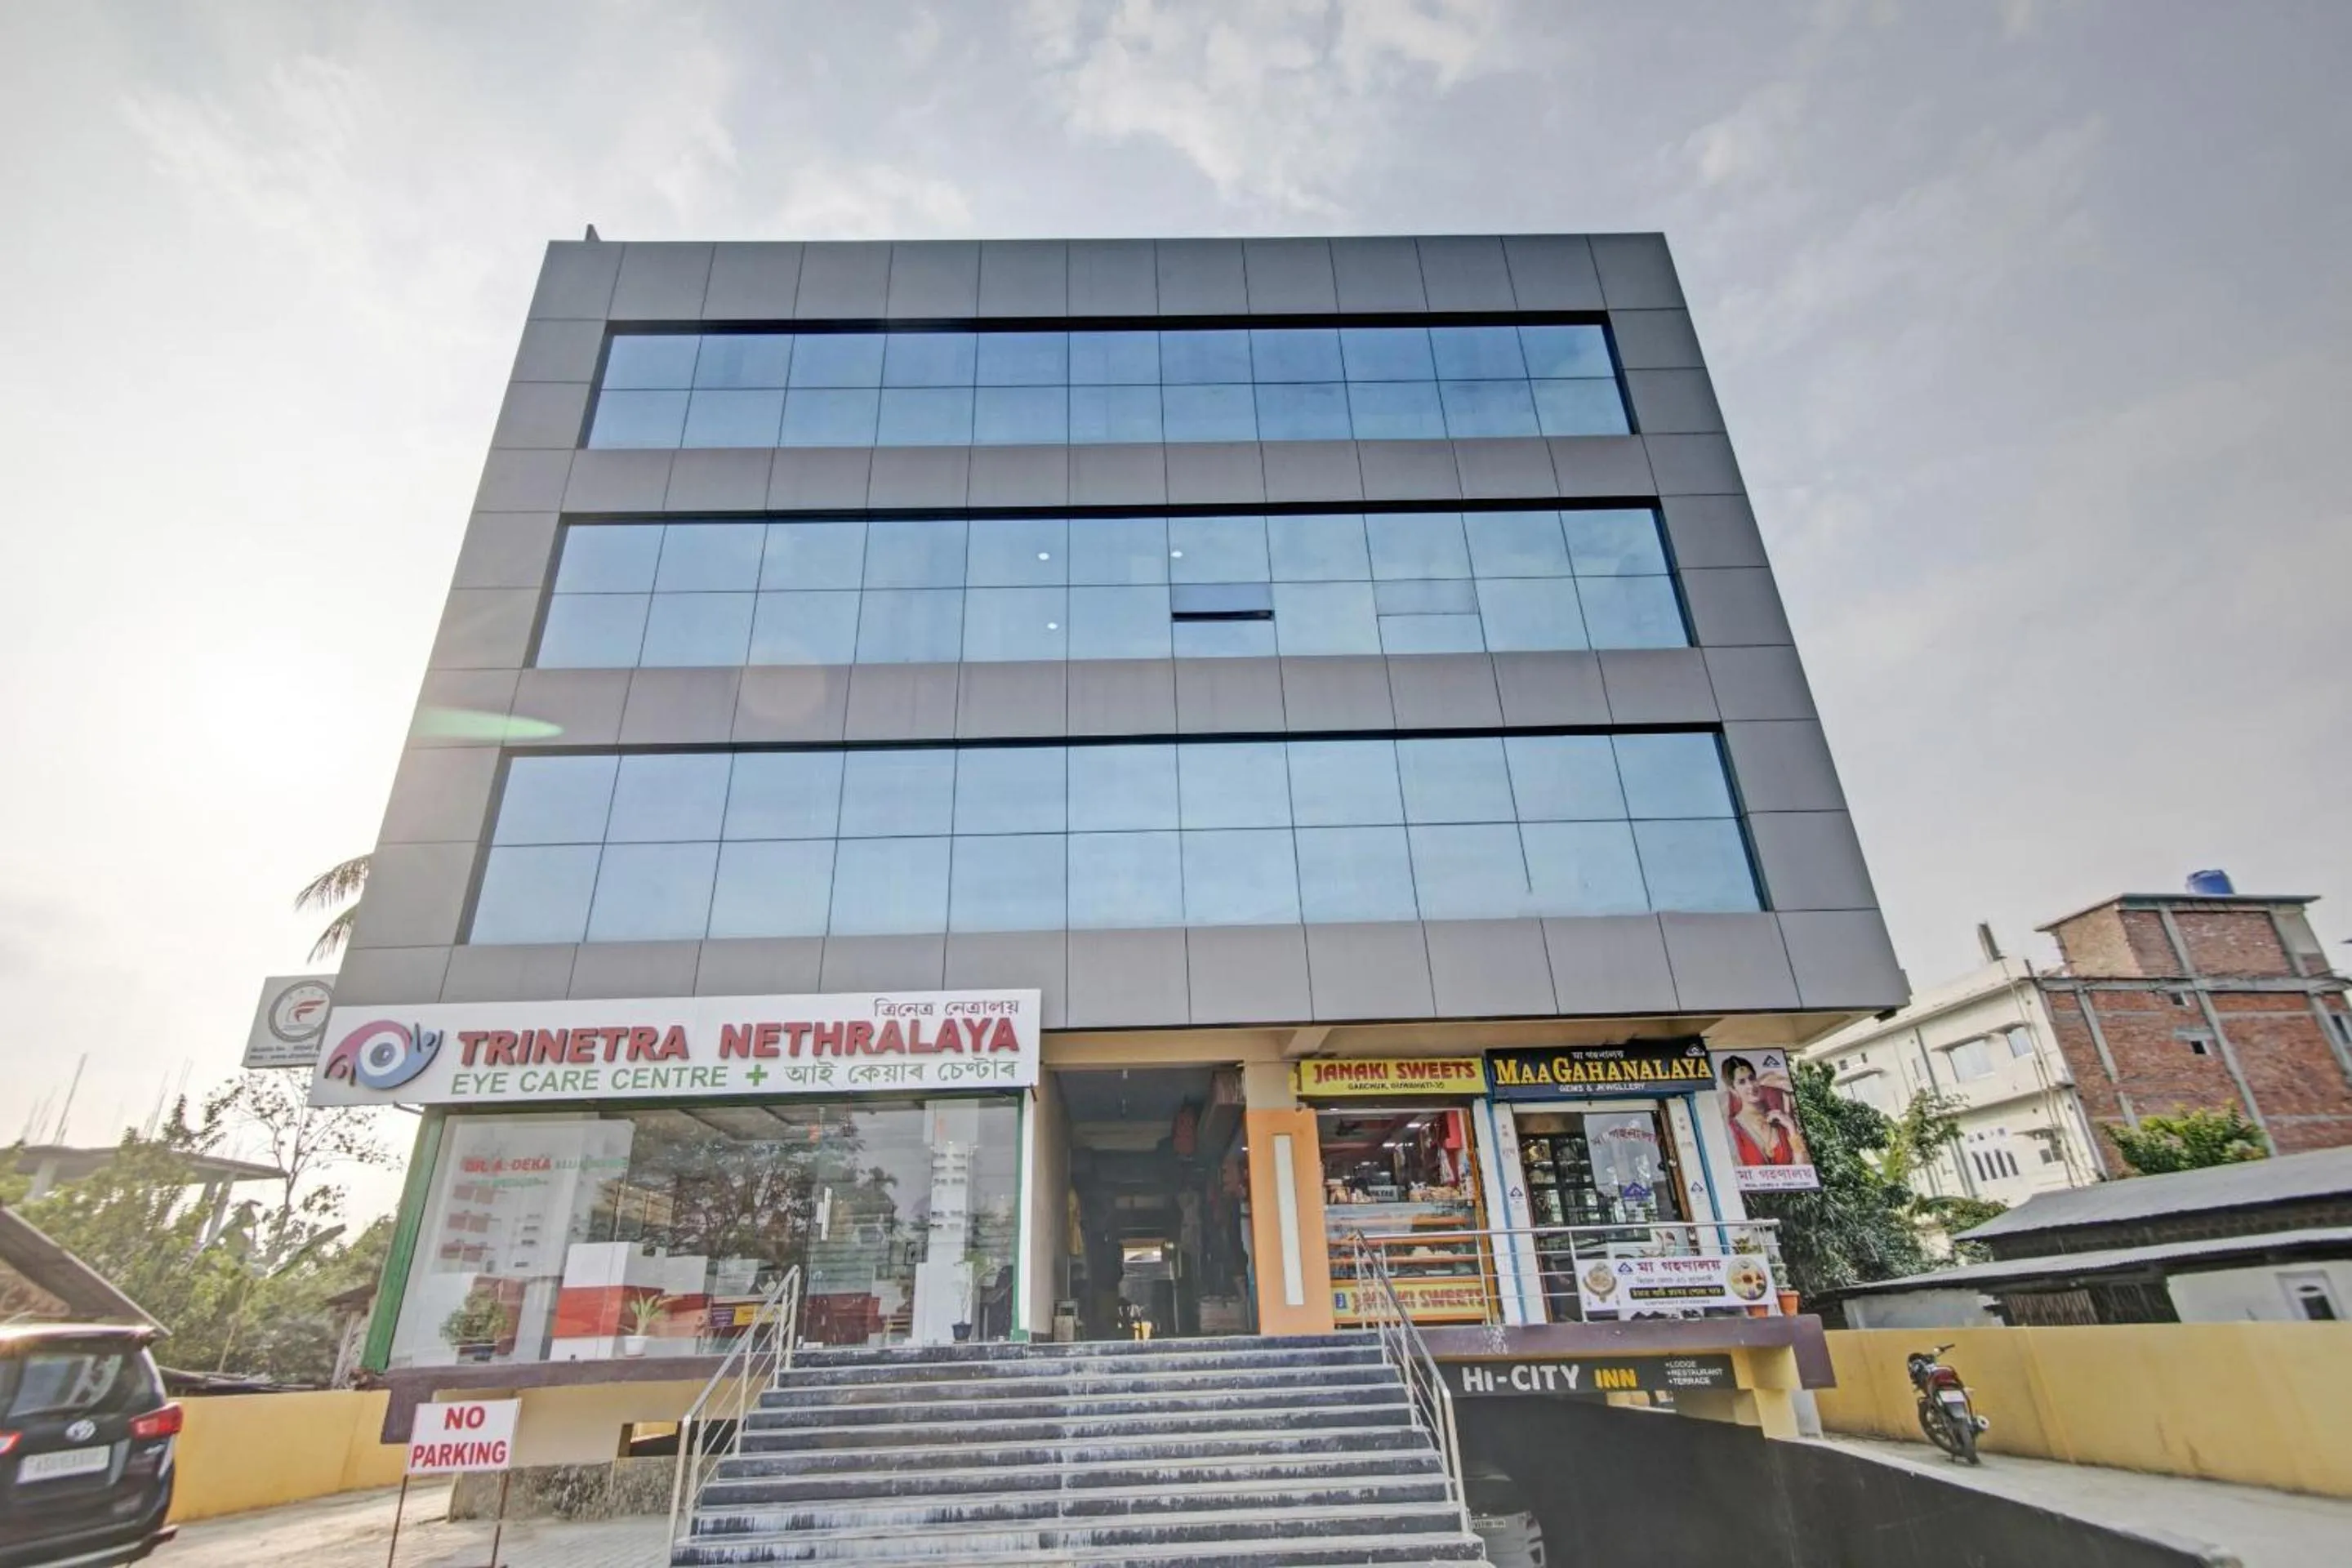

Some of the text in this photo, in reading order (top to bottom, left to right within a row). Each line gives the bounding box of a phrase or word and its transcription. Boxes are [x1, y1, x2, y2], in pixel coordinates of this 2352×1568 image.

[874, 997, 1020, 1018] ত্রিনেত্র নেত্রালয়
[457, 1016, 1021, 1067] TRINETRA NETHRALAYA
[450, 1065, 728, 1096] EYE CARE CENTRE
[784, 1060, 839, 1086] আই
[1313, 1060, 1476, 1083] JANAKI SWEETS
[1494, 1057, 1713, 1085] MAA GAHANALAYA
[1558, 1084, 1584, 1093] GEMS
[510, 1158, 552, 1171] DEKA
[1594, 1367, 1637, 1388] INN
[443, 1405, 486, 1431] NO
[410, 1440, 508, 1468] PARKING
